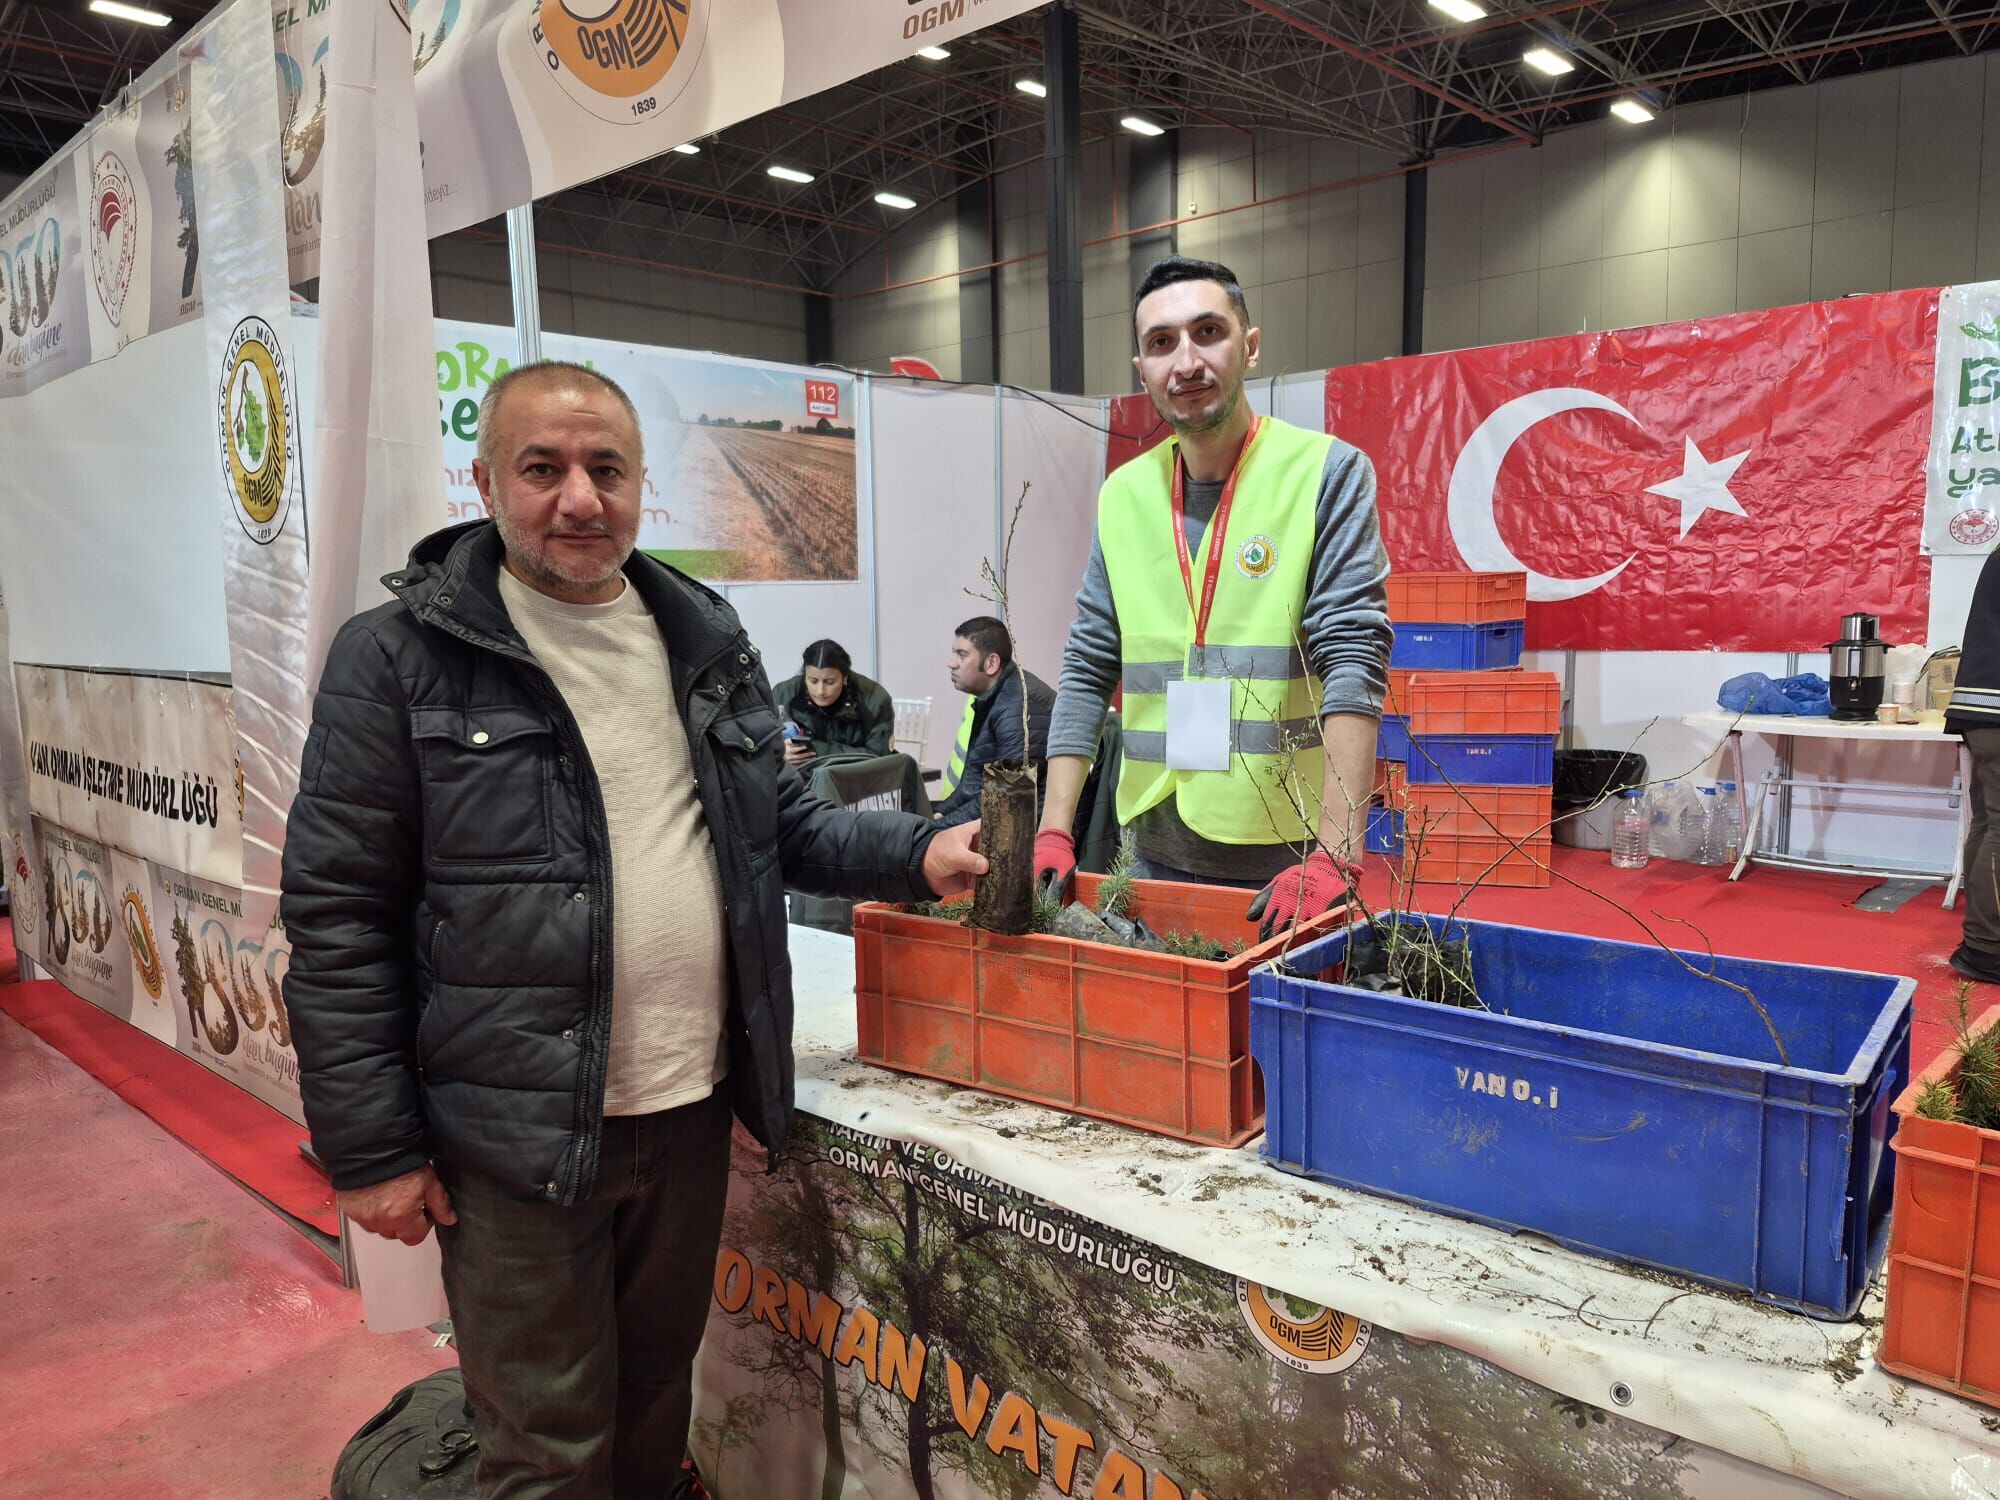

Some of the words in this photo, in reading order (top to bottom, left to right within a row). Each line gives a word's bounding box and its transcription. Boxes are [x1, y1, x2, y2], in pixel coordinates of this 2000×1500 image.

[902, 0, 965, 40] OGM
[577, 23, 636, 71] OGM
[631, 96, 657, 117] 1839
[227, 326, 250, 372] GENEL
[810, 384, 836, 401] 112
[243, 473, 263, 507] OGM
[31, 741, 50, 777] VAN
[50, 746, 80, 788] ORMAN
[82, 747, 123, 801] İŞLETME
[174, 884, 201, 905] ORMAN
[202, 894, 230, 914] GENEL
[264, 1042, 301, 1085] bugün
[900, 1141, 930, 1164] VE
[829, 1146, 914, 1185] ORMAN
[919, 1172, 990, 1222] GENEL
[998, 1205, 1174, 1291] MÜDÜRLÜĞÜ
[714, 1247, 927, 1403] ORMAN
[1269, 1315, 1301, 1348] OGM
[1286, 1356, 1310, 1370] 1839
